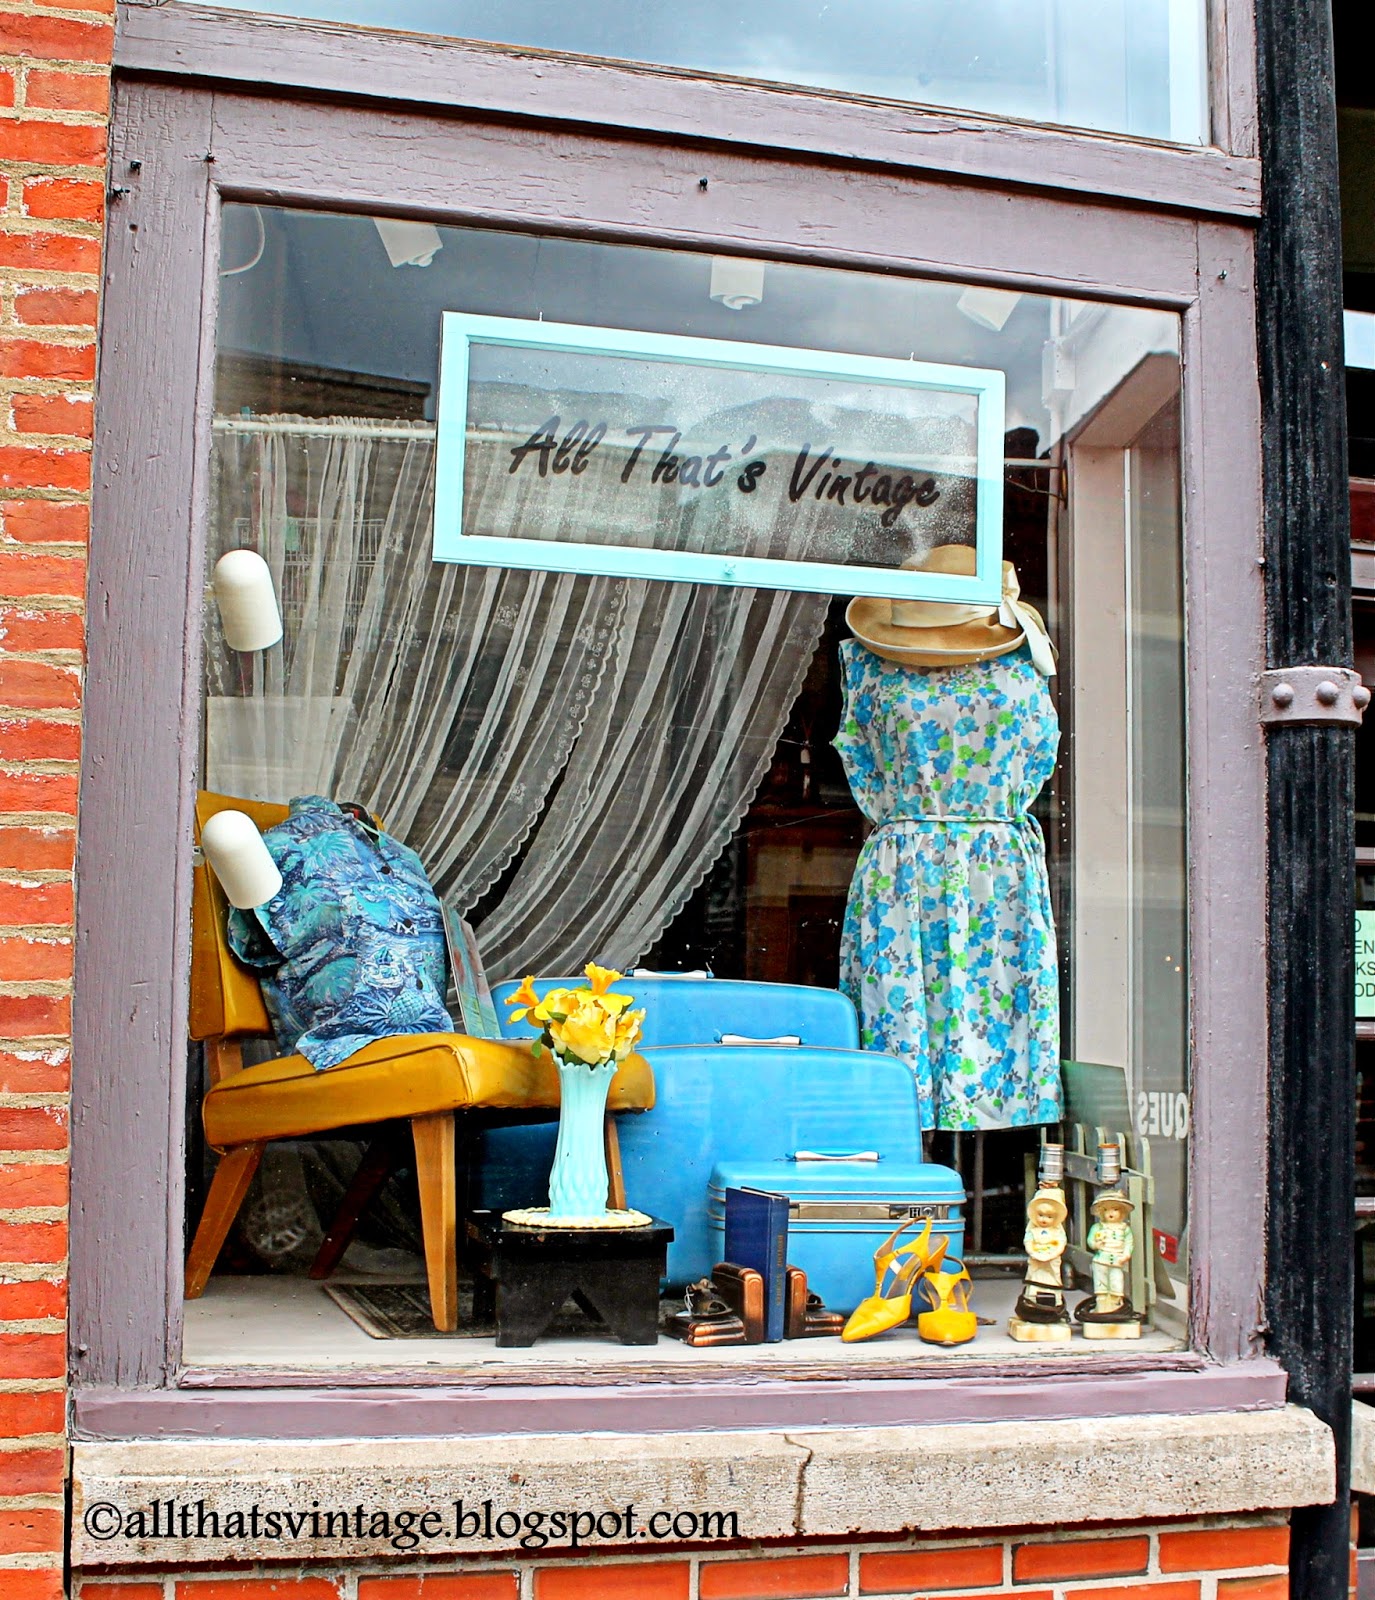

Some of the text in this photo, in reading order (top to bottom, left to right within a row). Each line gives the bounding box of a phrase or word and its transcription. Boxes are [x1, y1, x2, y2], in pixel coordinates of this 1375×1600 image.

[508, 415, 942, 527] All That's Vintage
